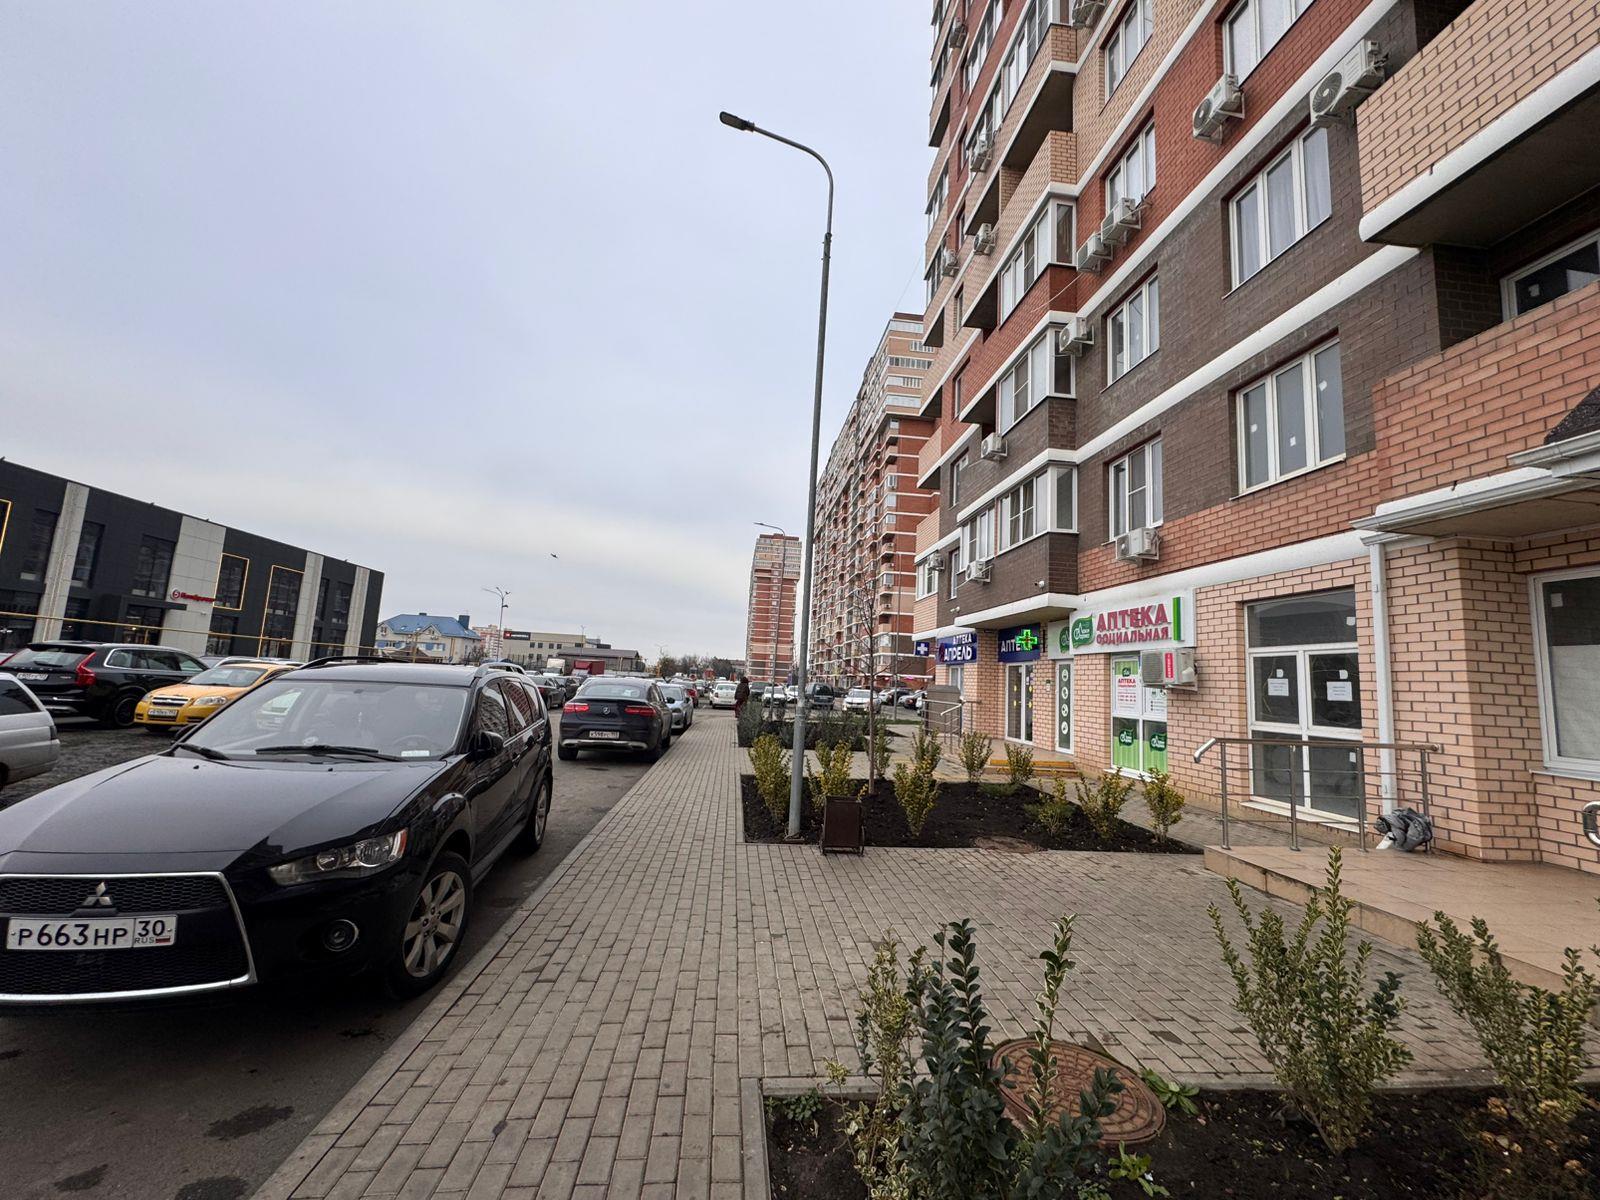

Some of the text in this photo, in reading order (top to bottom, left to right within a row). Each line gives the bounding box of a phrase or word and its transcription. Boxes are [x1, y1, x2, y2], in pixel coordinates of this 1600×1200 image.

[1097, 603, 1168, 632] АПТЕКА
[953, 633, 972, 644] АПТЕКА
[1096, 627, 1169, 645] СОЦИАЛЬНАЯ
[1000, 638, 1027, 653] АПТЕ
[944, 646, 972, 661] АПРЕЛЬ
[137, 919, 166, 937] 30
[135, 937, 155, 945] RUS
